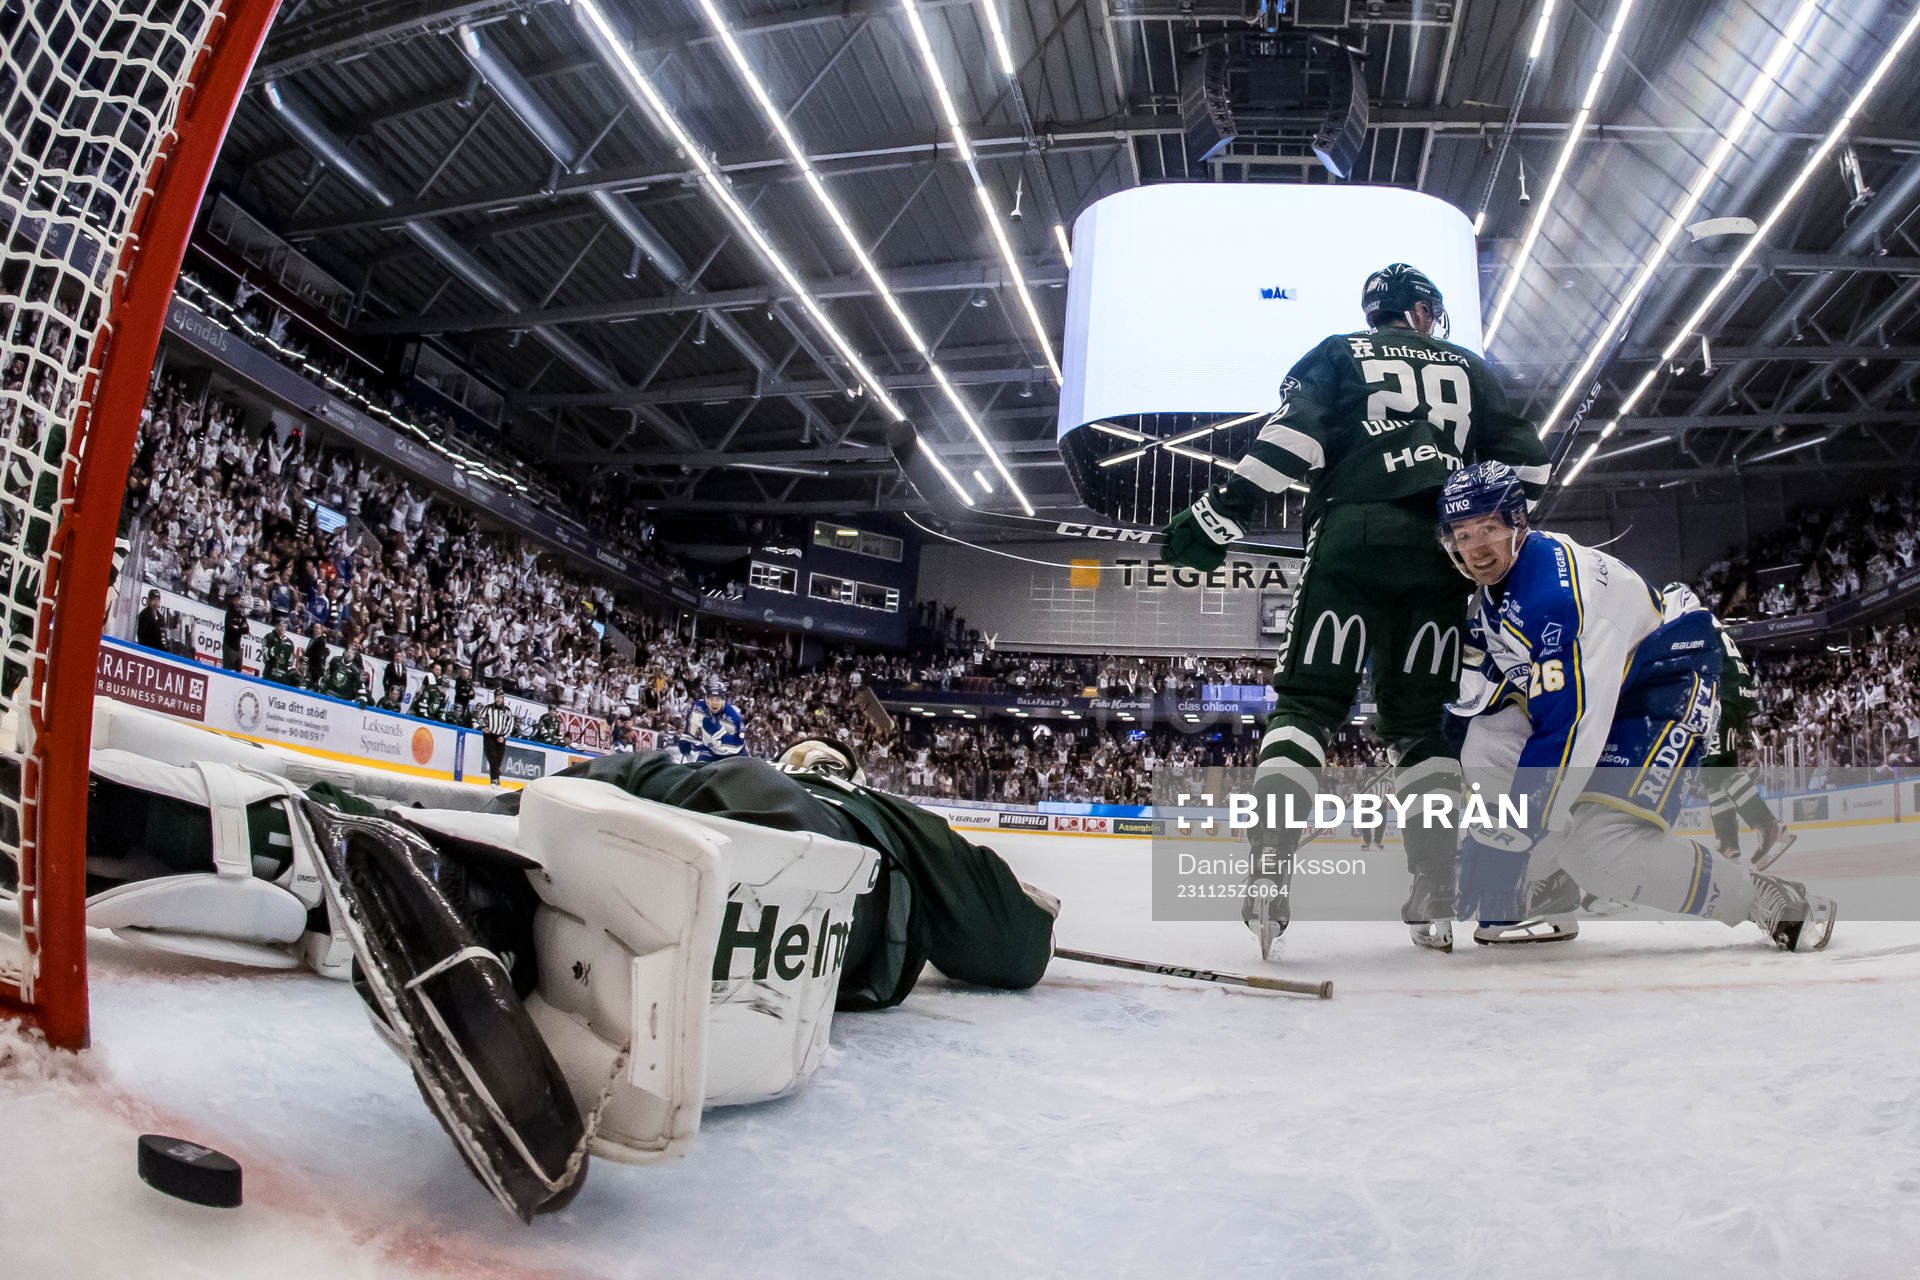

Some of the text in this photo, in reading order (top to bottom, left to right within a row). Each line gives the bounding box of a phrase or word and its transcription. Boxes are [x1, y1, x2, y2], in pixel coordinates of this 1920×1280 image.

[173, 310, 228, 352] ejendals
[1361, 360, 1472, 454] 28
[1445, 499, 1470, 514] LYKO
[1056, 522, 1152, 543] CCM
[1553, 547, 1568, 578] TEGERA
[1115, 559, 1289, 589] TEGERA
[1671, 640, 1704, 650] BAUER
[1529, 659, 1565, 699] 26
[106, 683, 156, 704] BUSINESS
[158, 695, 202, 714] PARTNER
[268, 696, 286, 710] Visa
[289, 701, 304, 714] ditt
[1178, 701, 1239, 712] clas ohlson
[362, 716, 403, 737] Leksands
[360, 735, 402, 755] Sparbank
[505, 757, 541, 777] Adven
[955, 815, 991, 824] BAUER
[1000, 814, 1047, 826] armenta
[1118, 823, 1161, 834] Assemblin
